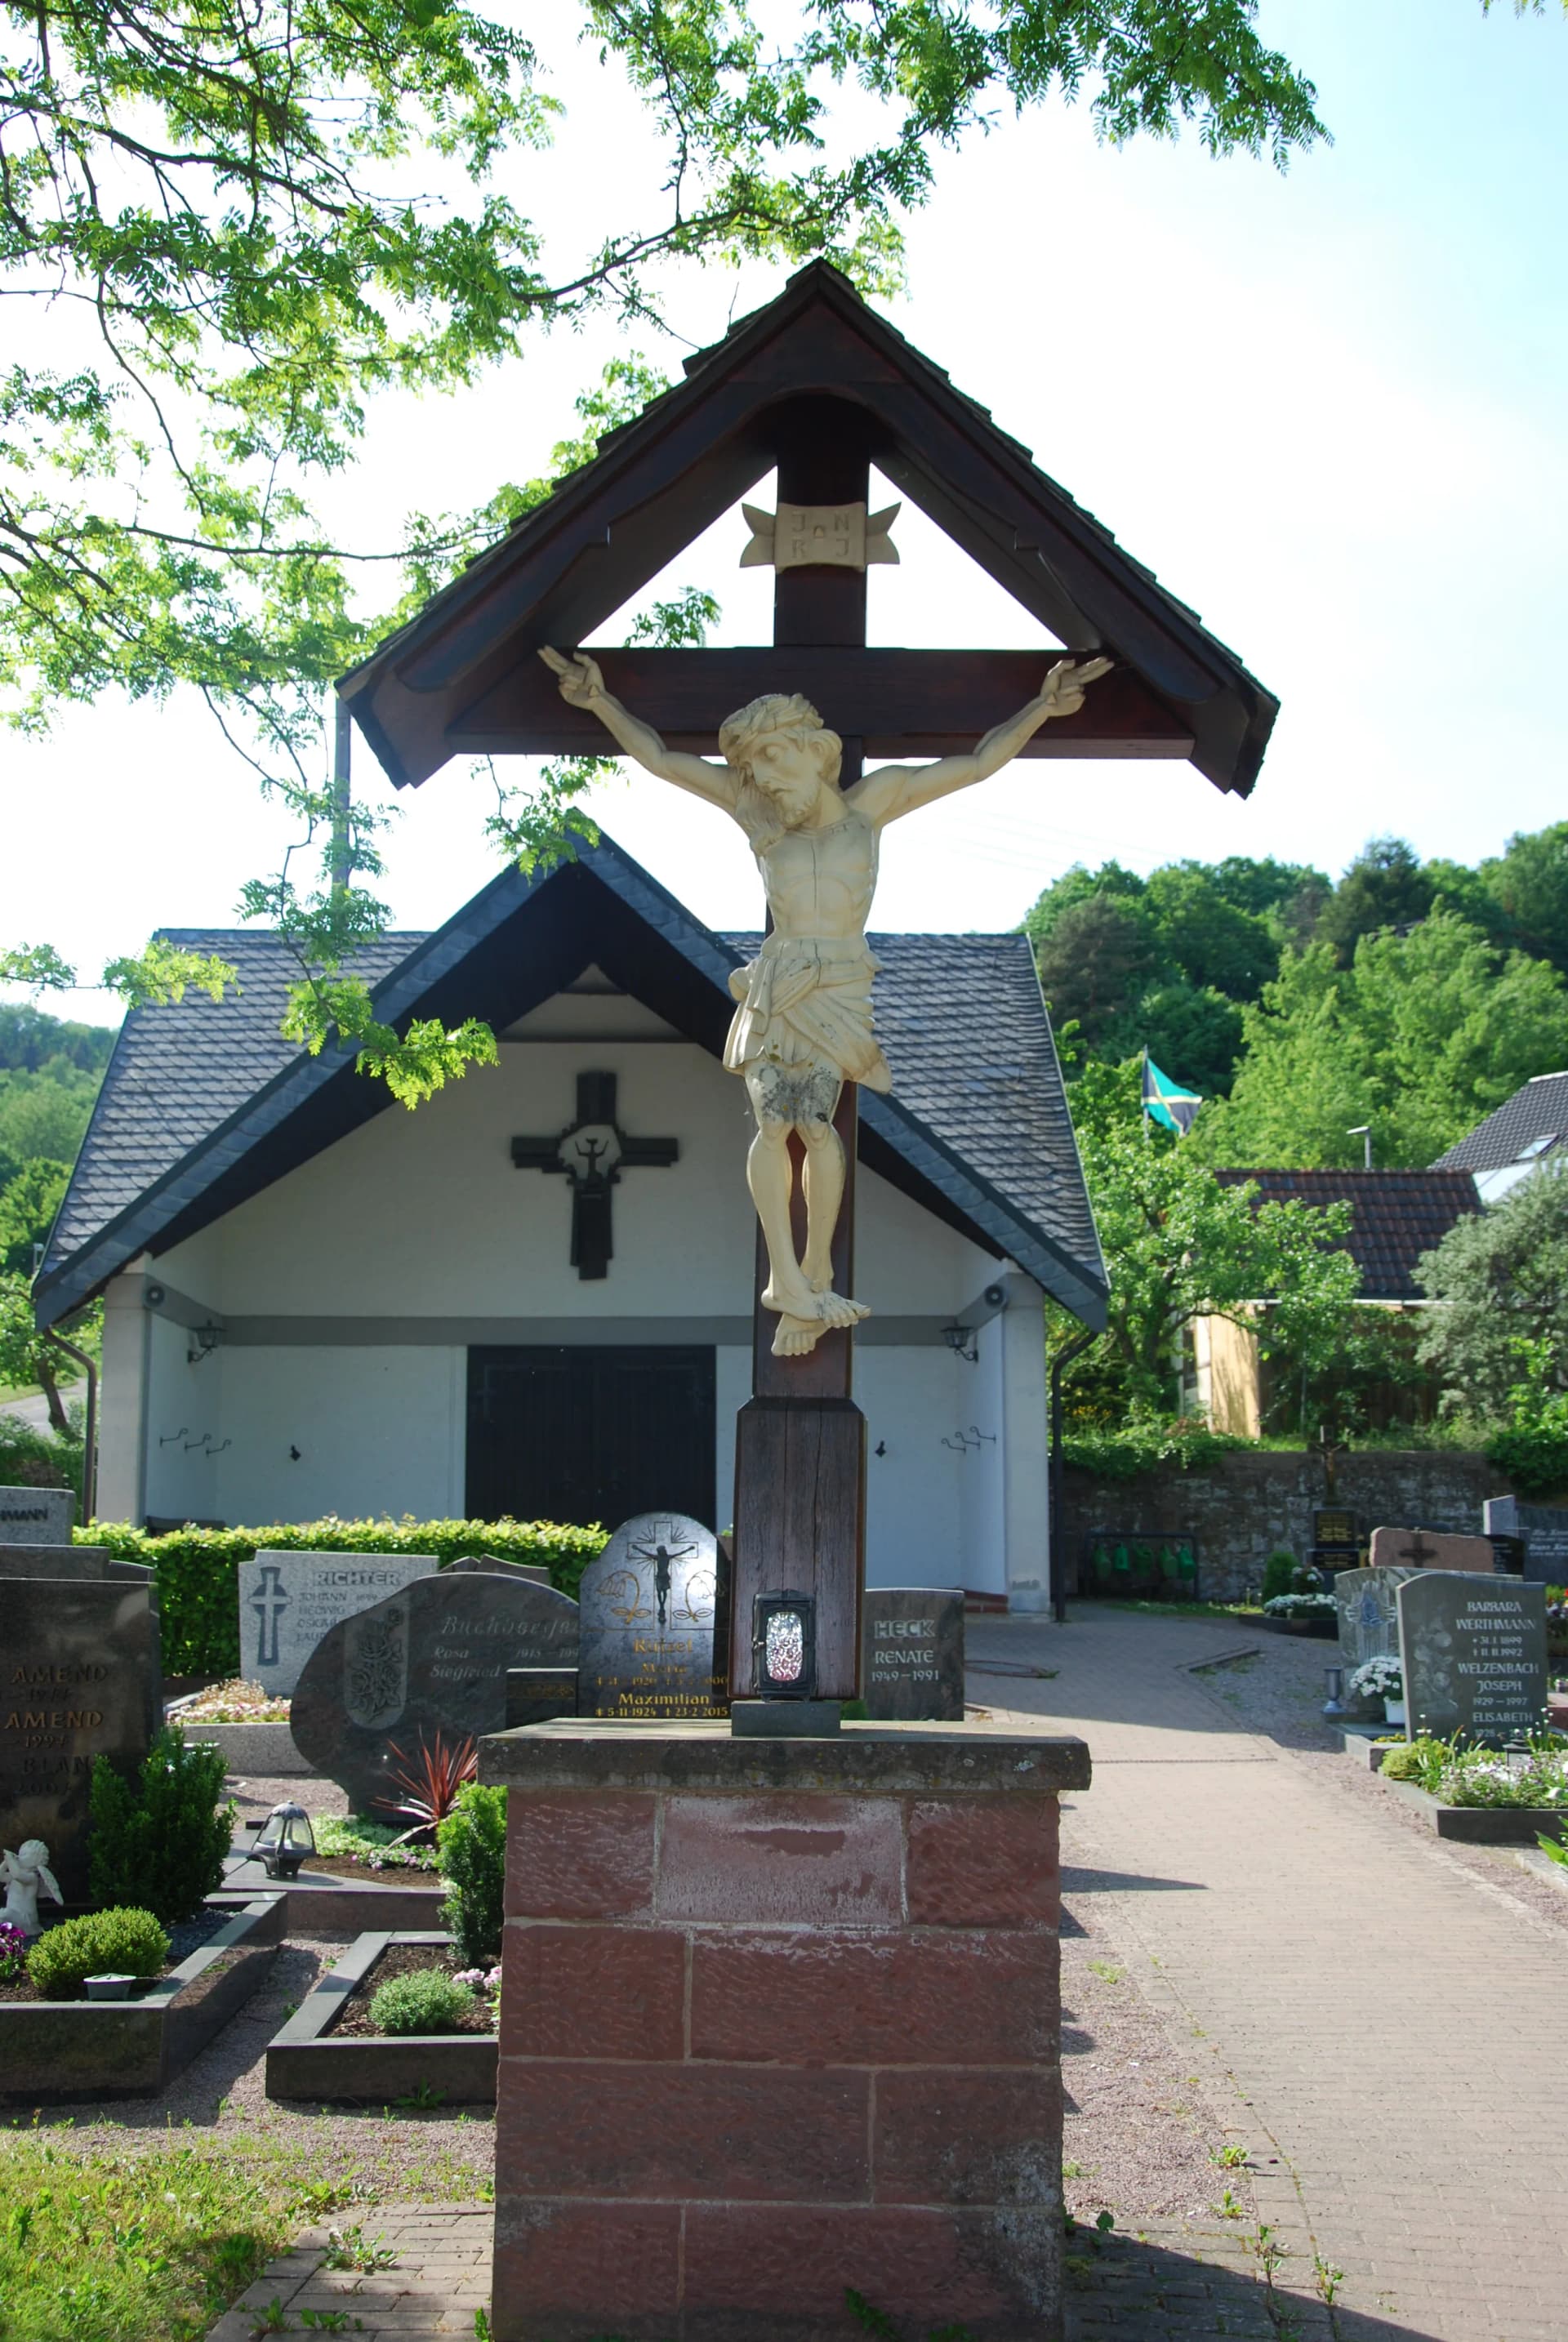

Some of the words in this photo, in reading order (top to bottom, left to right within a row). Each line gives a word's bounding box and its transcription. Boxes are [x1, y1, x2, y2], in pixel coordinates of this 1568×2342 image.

[834, 512, 849, 532] N
[313, 1571, 400, 1585] RICHTER
[1467, 1601, 1522, 1613] BARBARA
[874, 1619, 935, 1639] HECK
[1455, 1618, 1537, 1630] WERTHMANN
[434, 1645, 470, 1659] Rosa
[875, 1650, 934, 1664] RENATE
[11, 1664, 109, 1684] AMEND
[430, 1663, 502, 1681] Siegfried
[1457, 1663, 1540, 1674] WELZENBACH
[1476, 1680, 1522, 1694] JOSEPH
[618, 1693, 710, 1706] Maximilian
[3, 1711, 105, 1730] AMEND
[1472, 1712, 1534, 1722] ELISABETH
